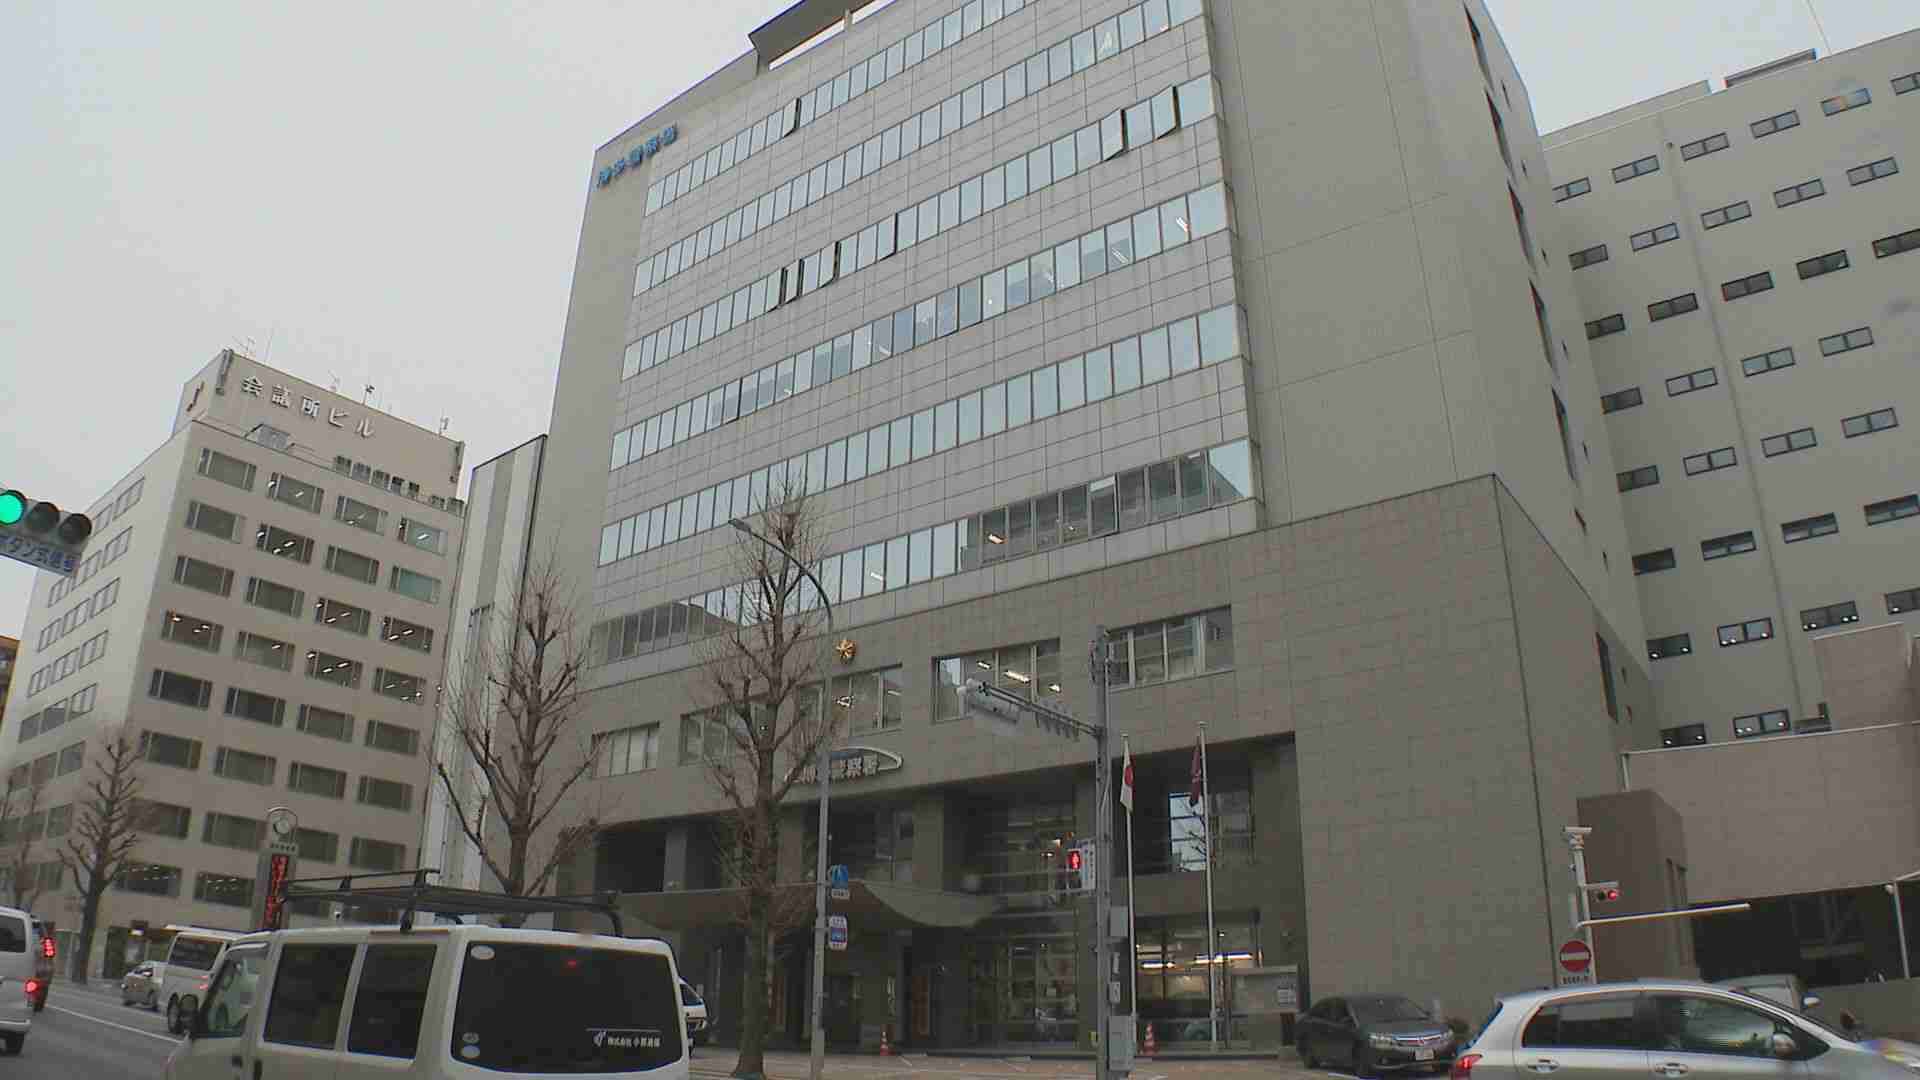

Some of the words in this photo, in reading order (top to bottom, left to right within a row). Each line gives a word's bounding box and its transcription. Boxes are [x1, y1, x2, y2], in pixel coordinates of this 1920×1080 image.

[240, 375, 375, 437] 会議所ビル
